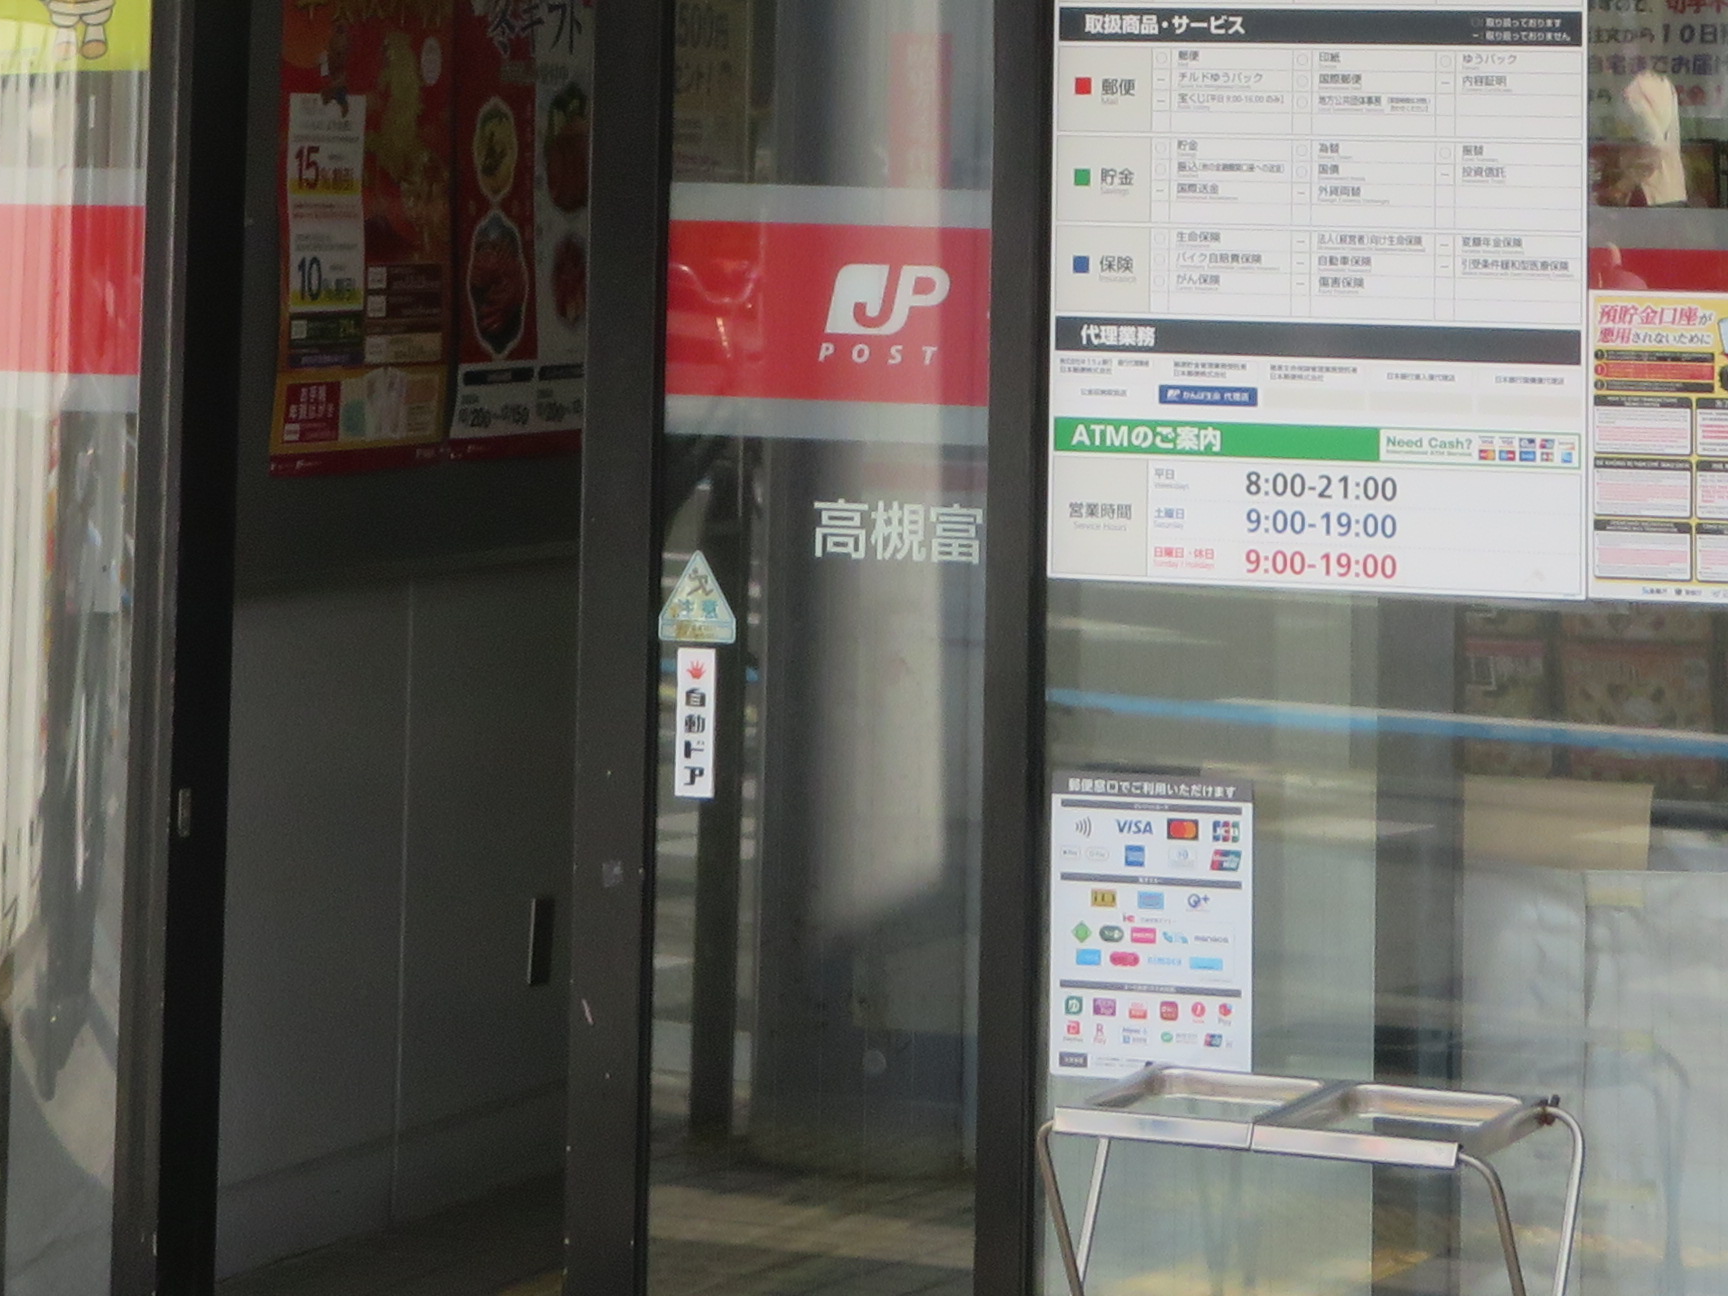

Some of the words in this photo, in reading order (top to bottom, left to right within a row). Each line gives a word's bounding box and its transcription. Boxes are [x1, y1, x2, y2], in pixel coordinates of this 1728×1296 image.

[1084, 13, 1246, 36] 取扱商品・サービス
[1177, 49, 1200, 62] 郵便
[1318, 51, 1341, 64] 印紙
[1461, 53, 1518, 65] ゆうパック
[1177, 71, 1264, 84] チルドゆうパック
[1318, 73, 1363, 86] 国際郵便
[1461, 75, 1509, 88] 内容証明
[1101, 77, 1136, 96] 郵便
[1177, 139, 1199, 152] 貯金
[1099, 167, 1135, 186] 貯金
[1318, 185, 1362, 198] 外貨両替
[1175, 231, 1222, 244] 生命保険
[1099, 254, 1135, 274] 保険
[1317, 255, 1373, 268] 自動車保険
[1175, 274, 1222, 287] がん保険
[1317, 276, 1365, 289] 傷害保険
[1597, 303, 1713, 325] 預貯金口座が
[1080, 323, 1155, 348] 代理業務
[1597, 328, 1712, 346] 悪用されないために
[818, 344, 939, 365] POST
[1071, 426, 1222, 453] ATMのご案内
[1384, 434, 1424, 450] Need
[1426, 435, 1473, 451] Cash?
[1153, 468, 1176, 481] 平日
[1244, 469, 1398, 503] 8:00-21:00
[1068, 501, 1133, 521] 営業時間
[1153, 507, 1186, 520] 土曜日
[813, 498, 984, 565] 高槻富
[1073, 521, 1103, 532] Service
[1244, 507, 1398, 540] 9:00-19:00
[1153, 545, 1216, 561] 日曜日・休日
[1244, 548, 1398, 579] 9:00-19:00
[683, 687, 706, 786] 自動ドア
[1067, 777, 1237, 799] 郵便窓口でご利用いただけます
[1115, 819, 1154, 835] VISA
